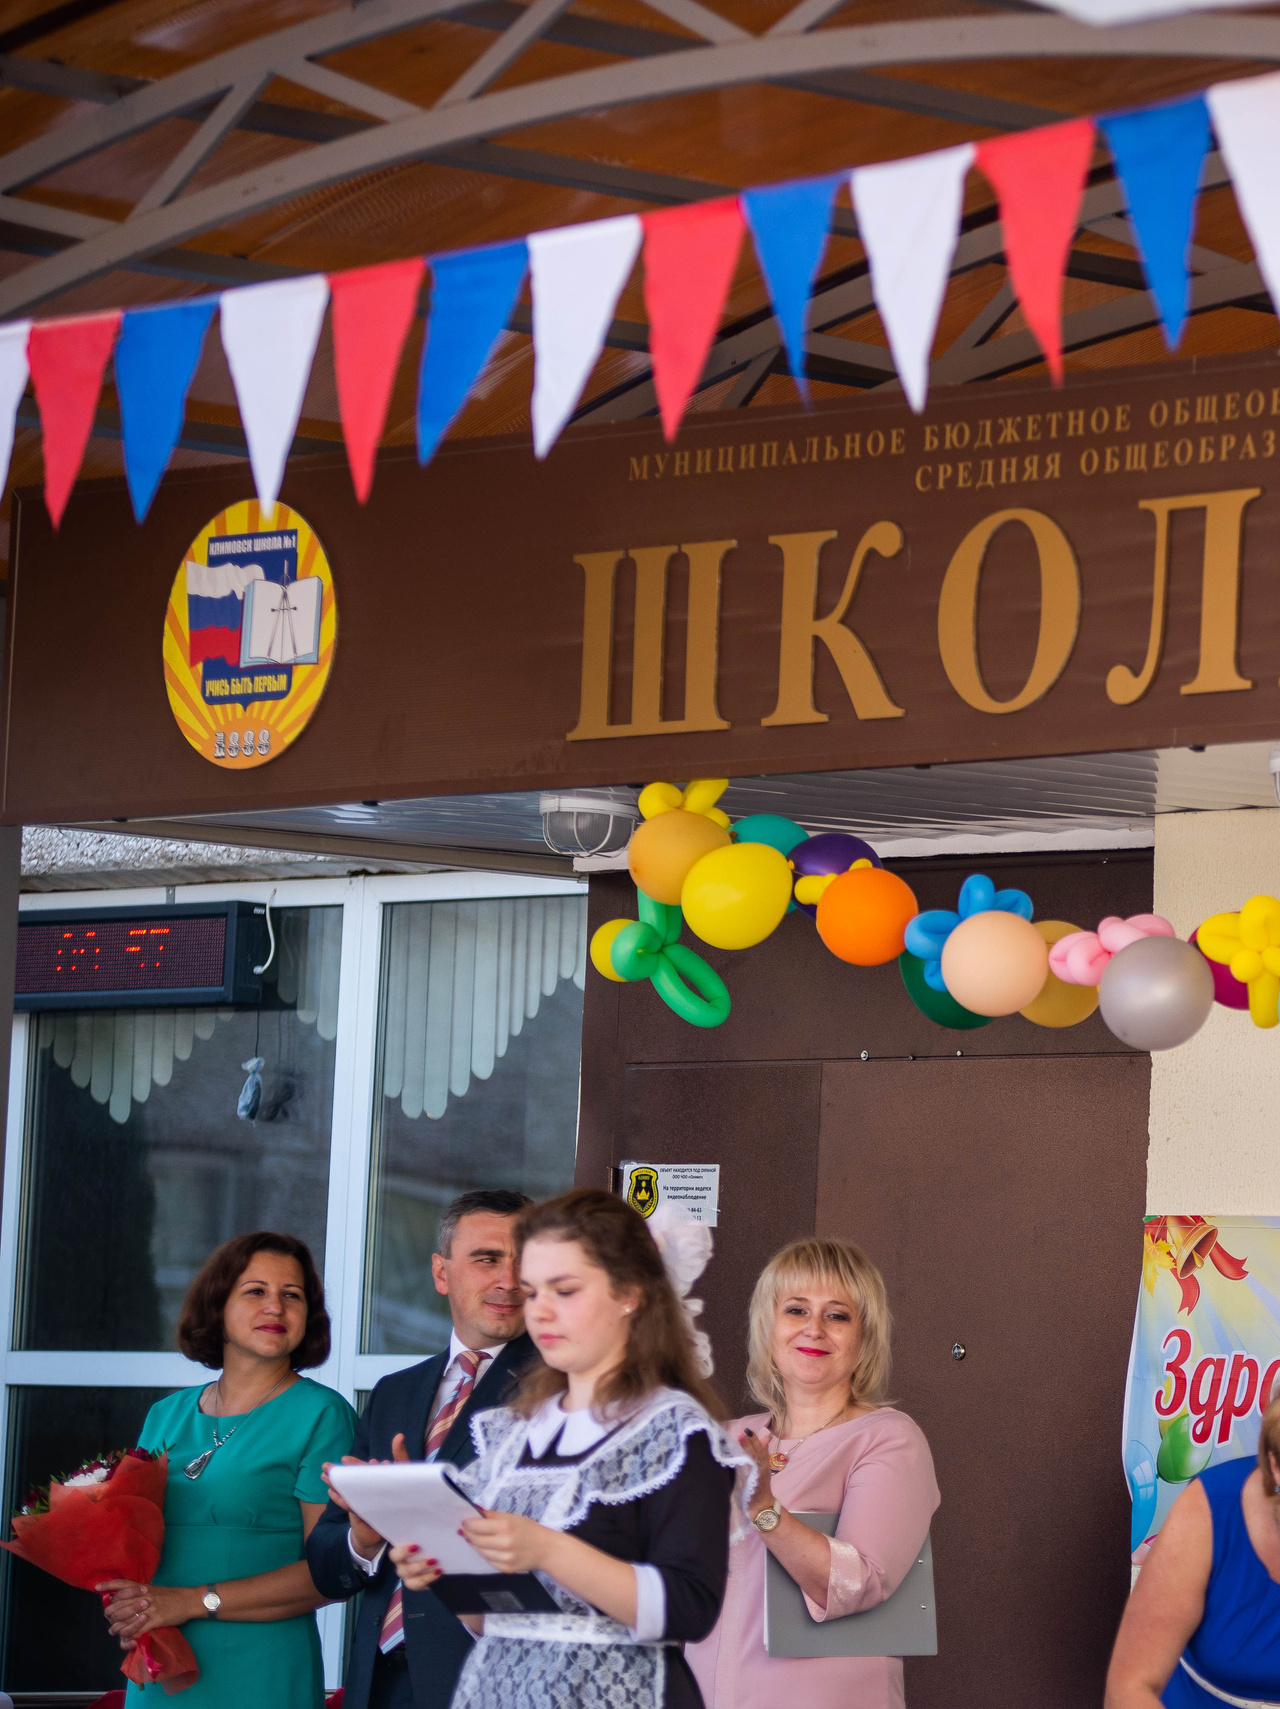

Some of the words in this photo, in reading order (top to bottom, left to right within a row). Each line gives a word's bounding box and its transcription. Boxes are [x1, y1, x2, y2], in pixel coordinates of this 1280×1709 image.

[627, 428, 906, 482] МУНИЦИПАЛЬНОЕ
[922, 403, 1131, 453] БЮДЖЕТНОЕ
[914, 452, 1063, 493] СРЕДНЯЯ
[253, 536, 283, 552] ШКОЛА
[205, 679, 229, 697] УЧИСЬ
[230, 677, 252, 695] БЫТЬ
[253, 674, 288, 693] ПЕРВЫМ
